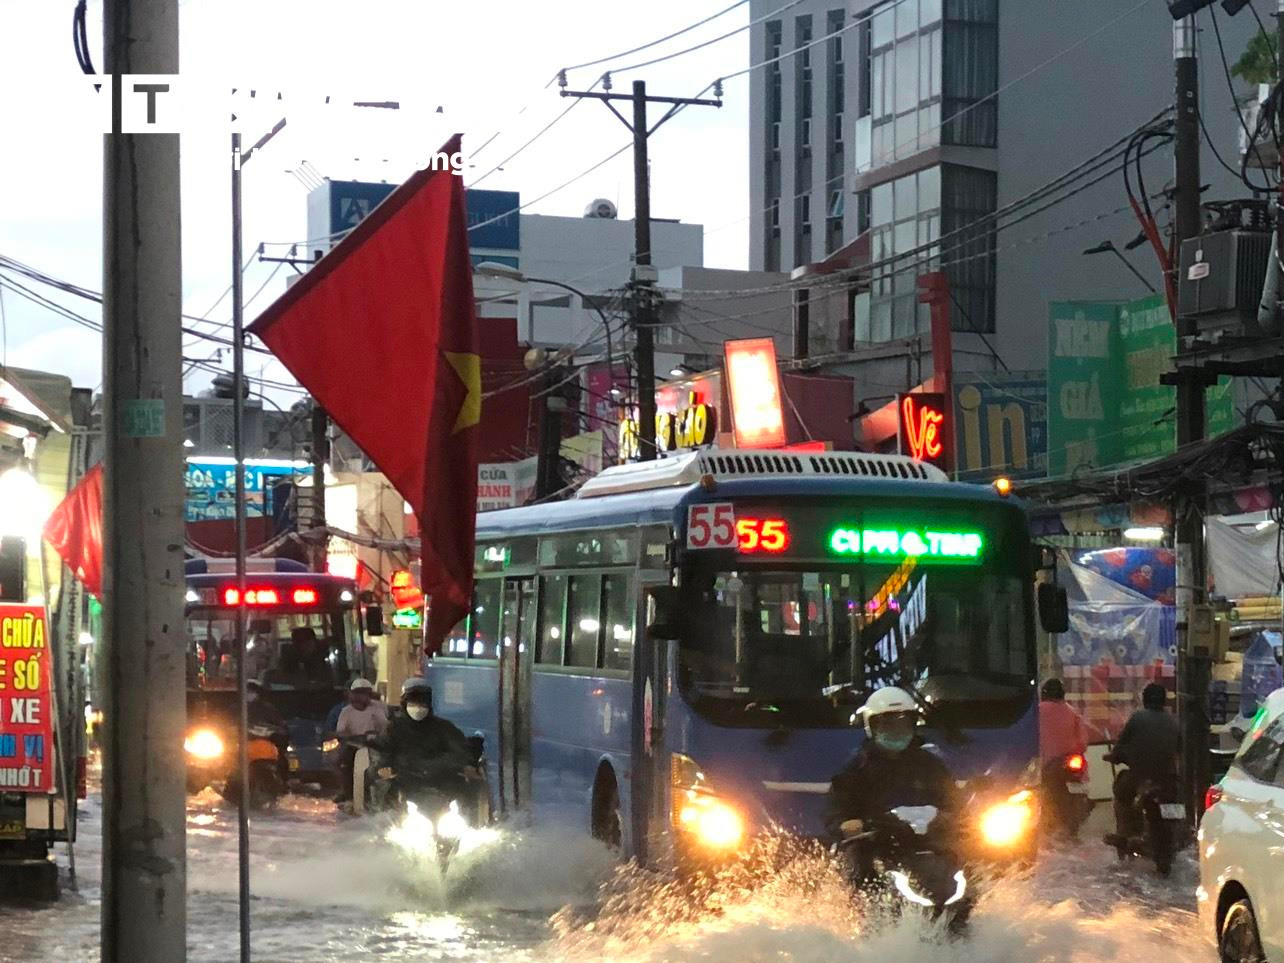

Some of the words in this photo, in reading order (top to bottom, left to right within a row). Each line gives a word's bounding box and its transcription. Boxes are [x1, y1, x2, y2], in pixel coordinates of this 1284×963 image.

[959, 385, 1028, 472] in
[689, 506, 735, 547] 55
[736, 520, 787, 550] 55
[2, 612, 45, 649] CHỮA
[13, 651, 41, 690] SỐ
[10, 698, 41, 723] XE
